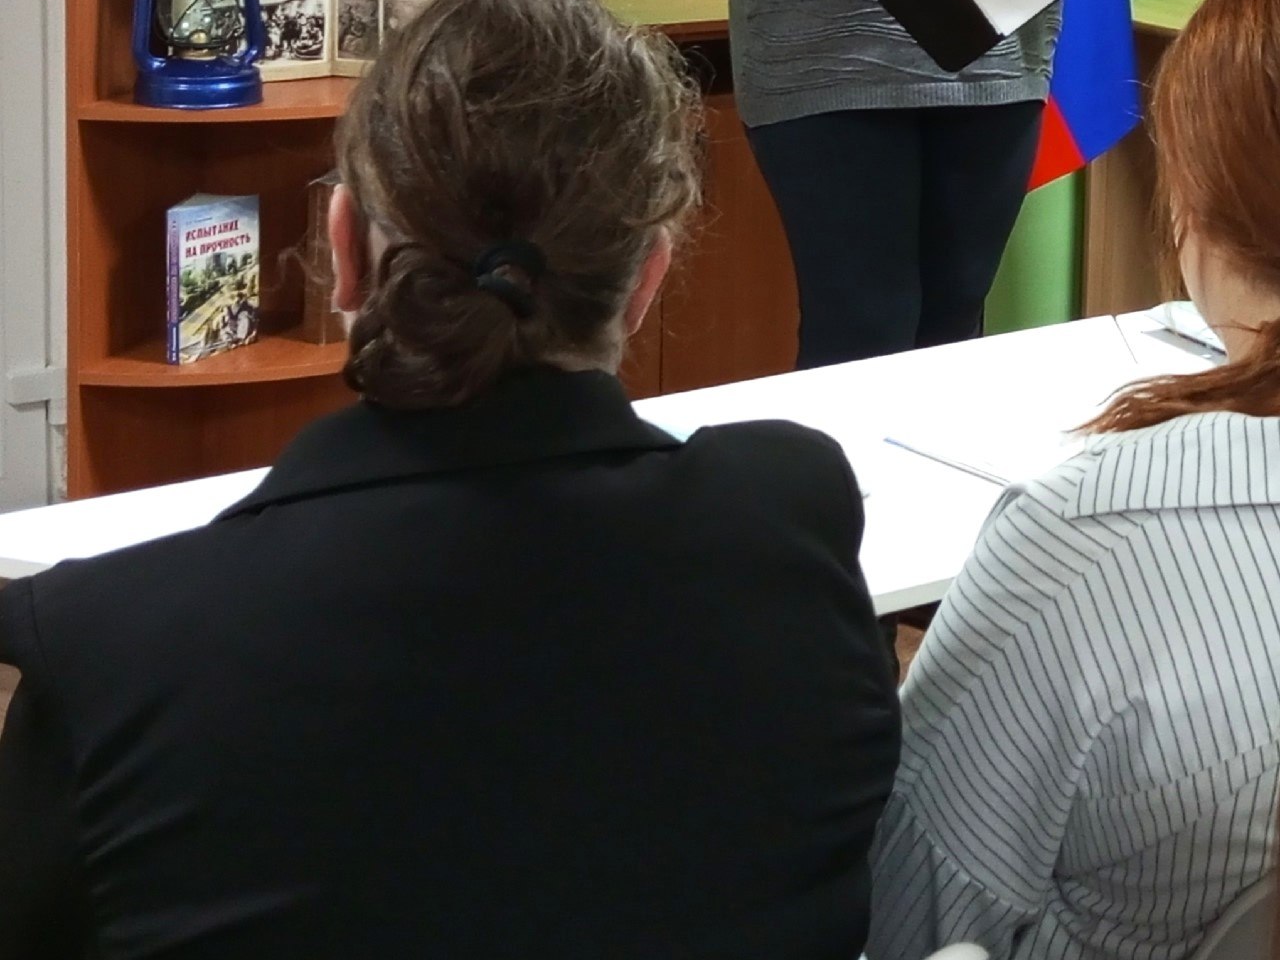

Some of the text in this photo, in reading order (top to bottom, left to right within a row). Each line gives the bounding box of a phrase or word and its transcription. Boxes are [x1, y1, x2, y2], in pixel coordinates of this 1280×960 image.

[185, 219, 239, 242] ИСПЫТАНИЕ
[185, 233, 251, 258] НА ПРОЧНОСТЬ
